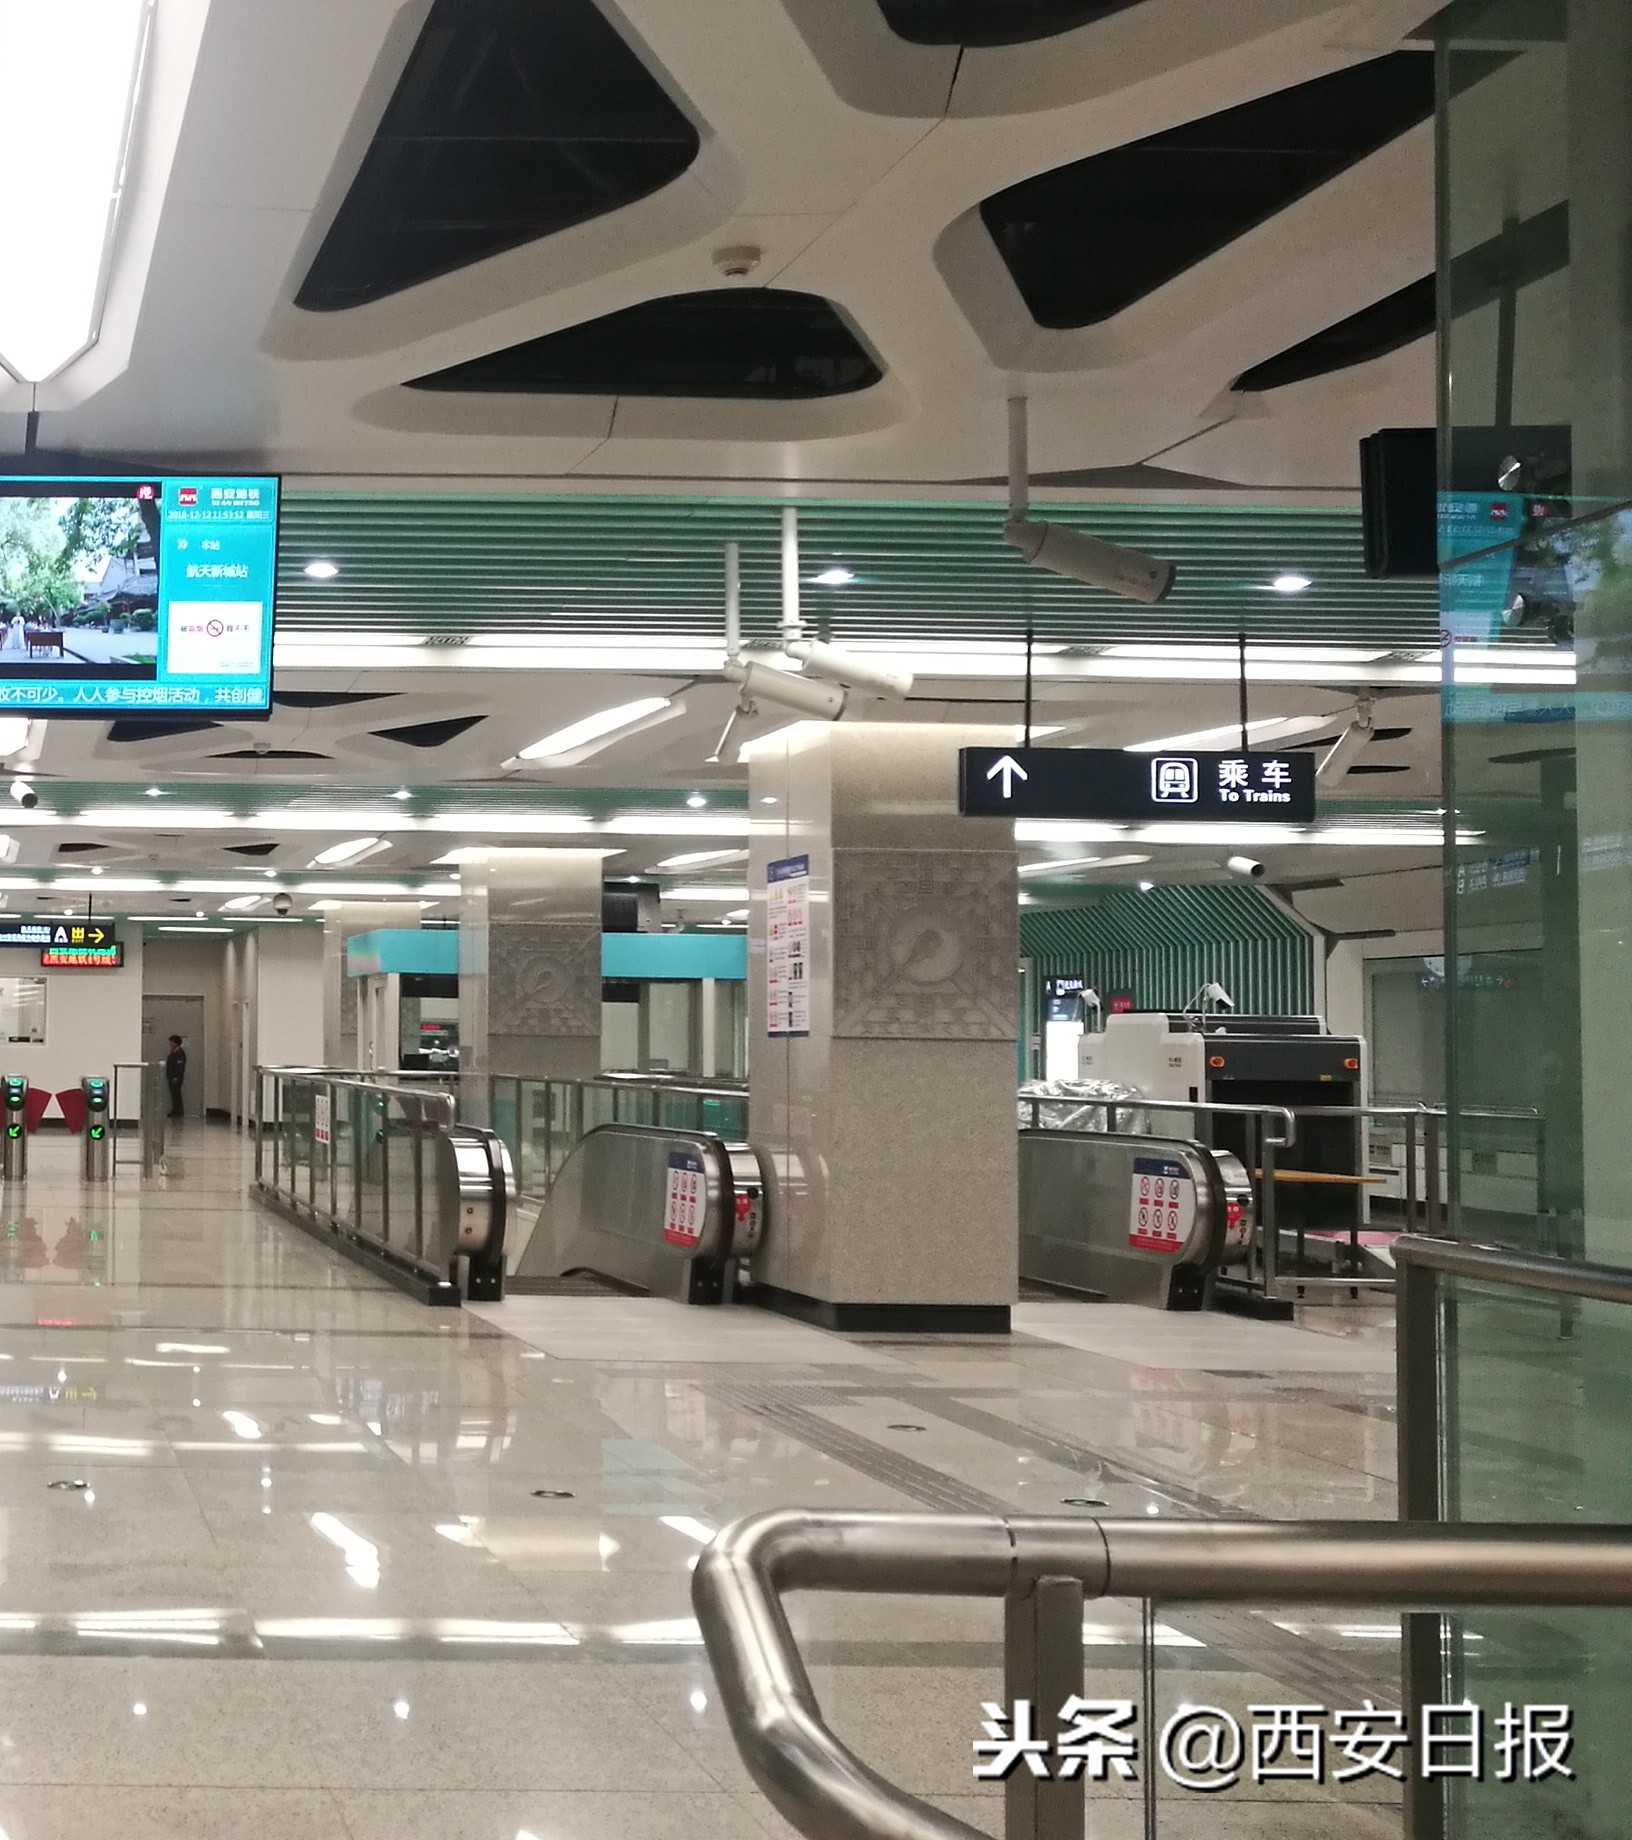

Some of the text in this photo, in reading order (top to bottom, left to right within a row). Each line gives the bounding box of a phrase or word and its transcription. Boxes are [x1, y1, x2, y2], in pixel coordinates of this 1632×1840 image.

[186, 564, 249, 578] 航天新城站
[1218, 759, 1292, 788] 乘车
[1218, 789, 1291, 802] To Trains
[54, 926, 68, 942] A
